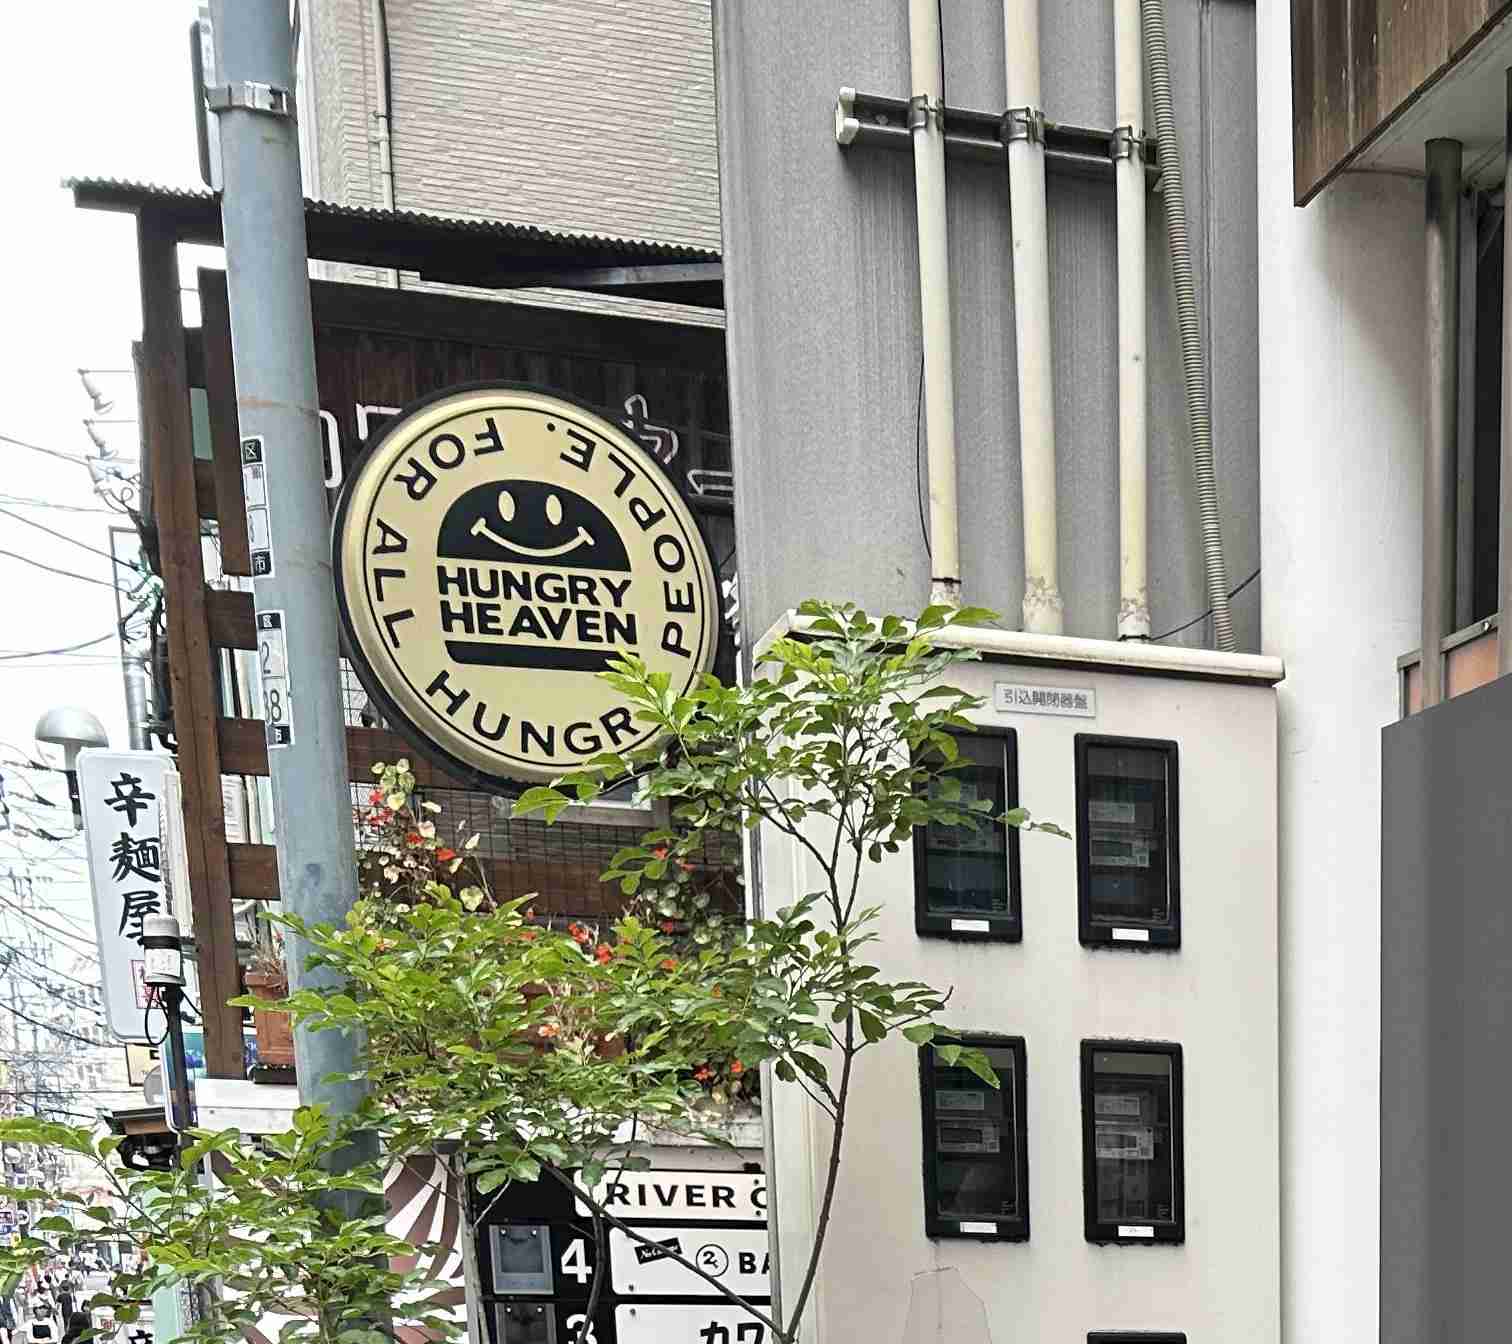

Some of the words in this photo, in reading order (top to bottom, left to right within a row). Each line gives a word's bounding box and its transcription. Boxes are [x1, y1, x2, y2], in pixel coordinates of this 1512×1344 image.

[394, 417, 505, 500] FOR
[372, 518, 415, 648] ALL
[437, 565, 632, 608] HUNGRY
[440, 600, 638, 646] HEAVEN
[425, 670, 641, 757] HUNGR
[606, 1183, 736, 1209] RIVER
[561, 1239, 593, 1284] 4
